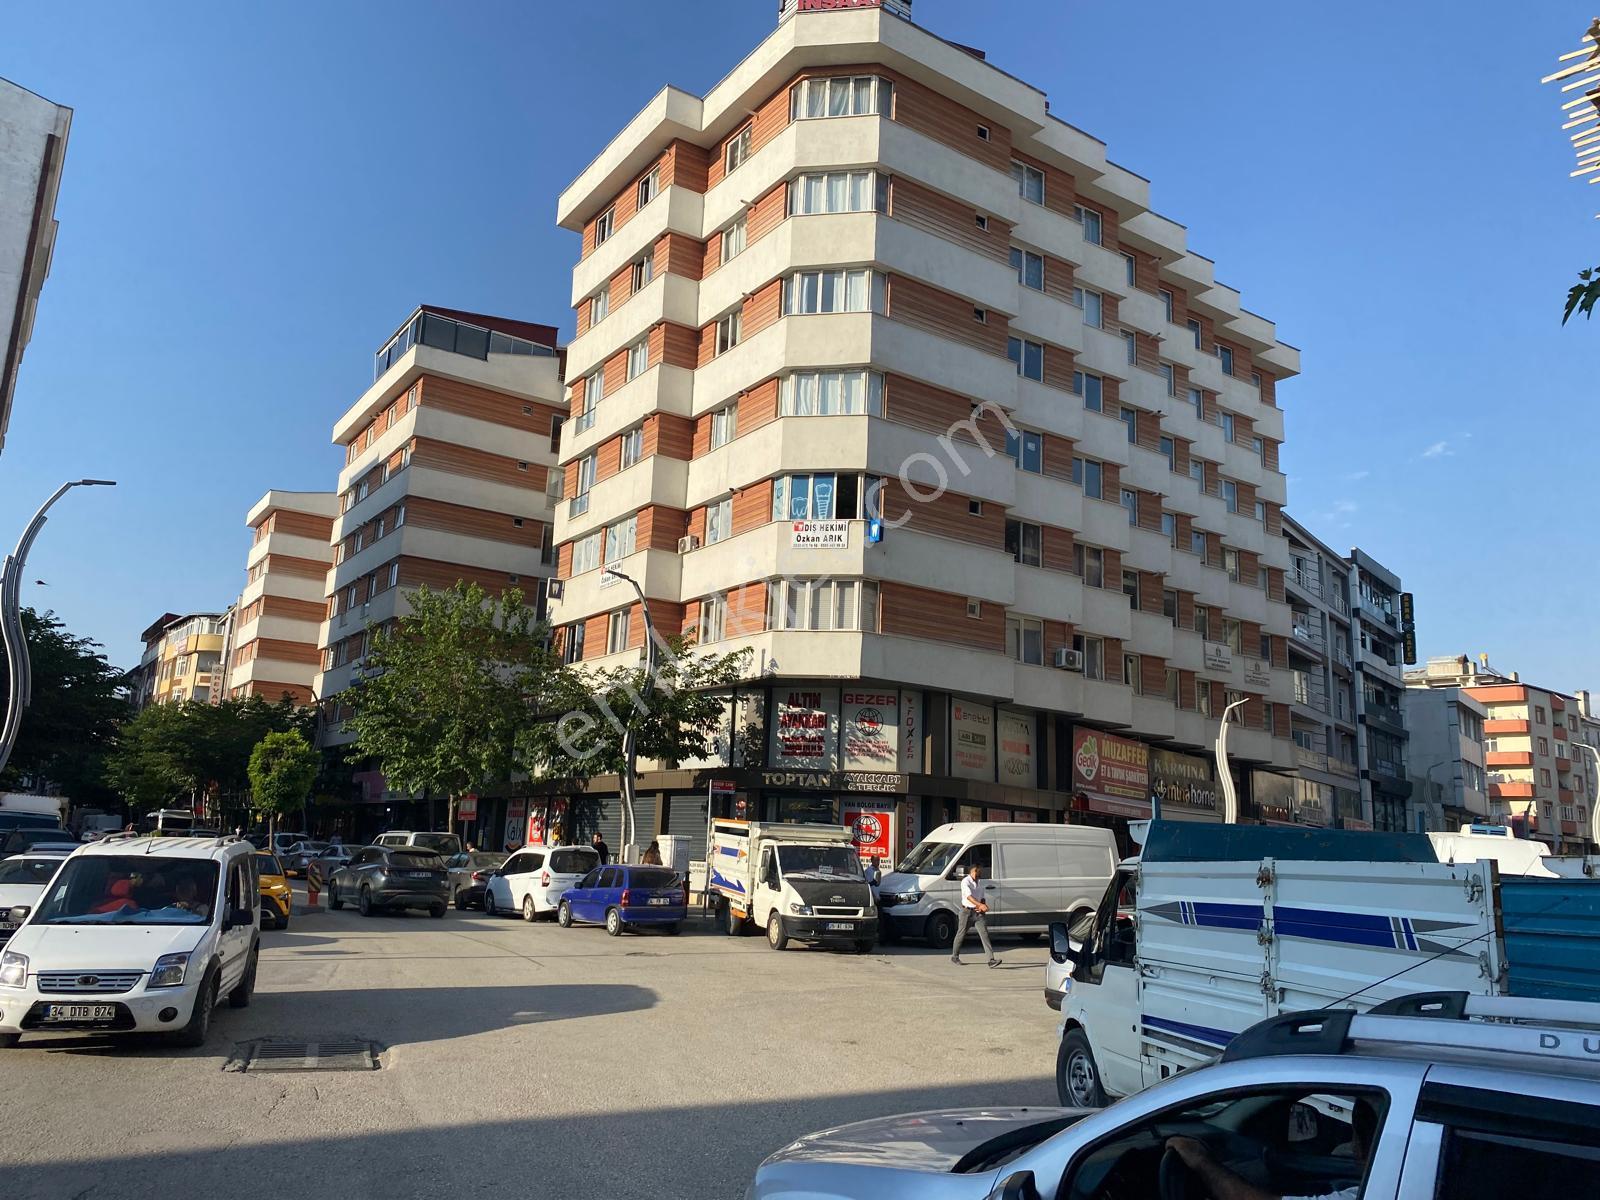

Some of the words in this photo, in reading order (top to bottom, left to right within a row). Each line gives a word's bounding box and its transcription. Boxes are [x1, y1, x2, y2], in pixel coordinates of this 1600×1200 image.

[820, 521, 846, 531] HEKİMİ
[796, 533, 820, 542] Özkan
[787, 692, 822, 708] ALTIN
[843, 693, 897, 706] GEZER
[1101, 739, 1148, 767] MUZAFFER
[761, 772, 831, 788] TOPTAN
[51, 1006, 63, 1017] 34
[70, 1006, 88, 1017] DTB
[94, 1006, 112, 1017] 874
